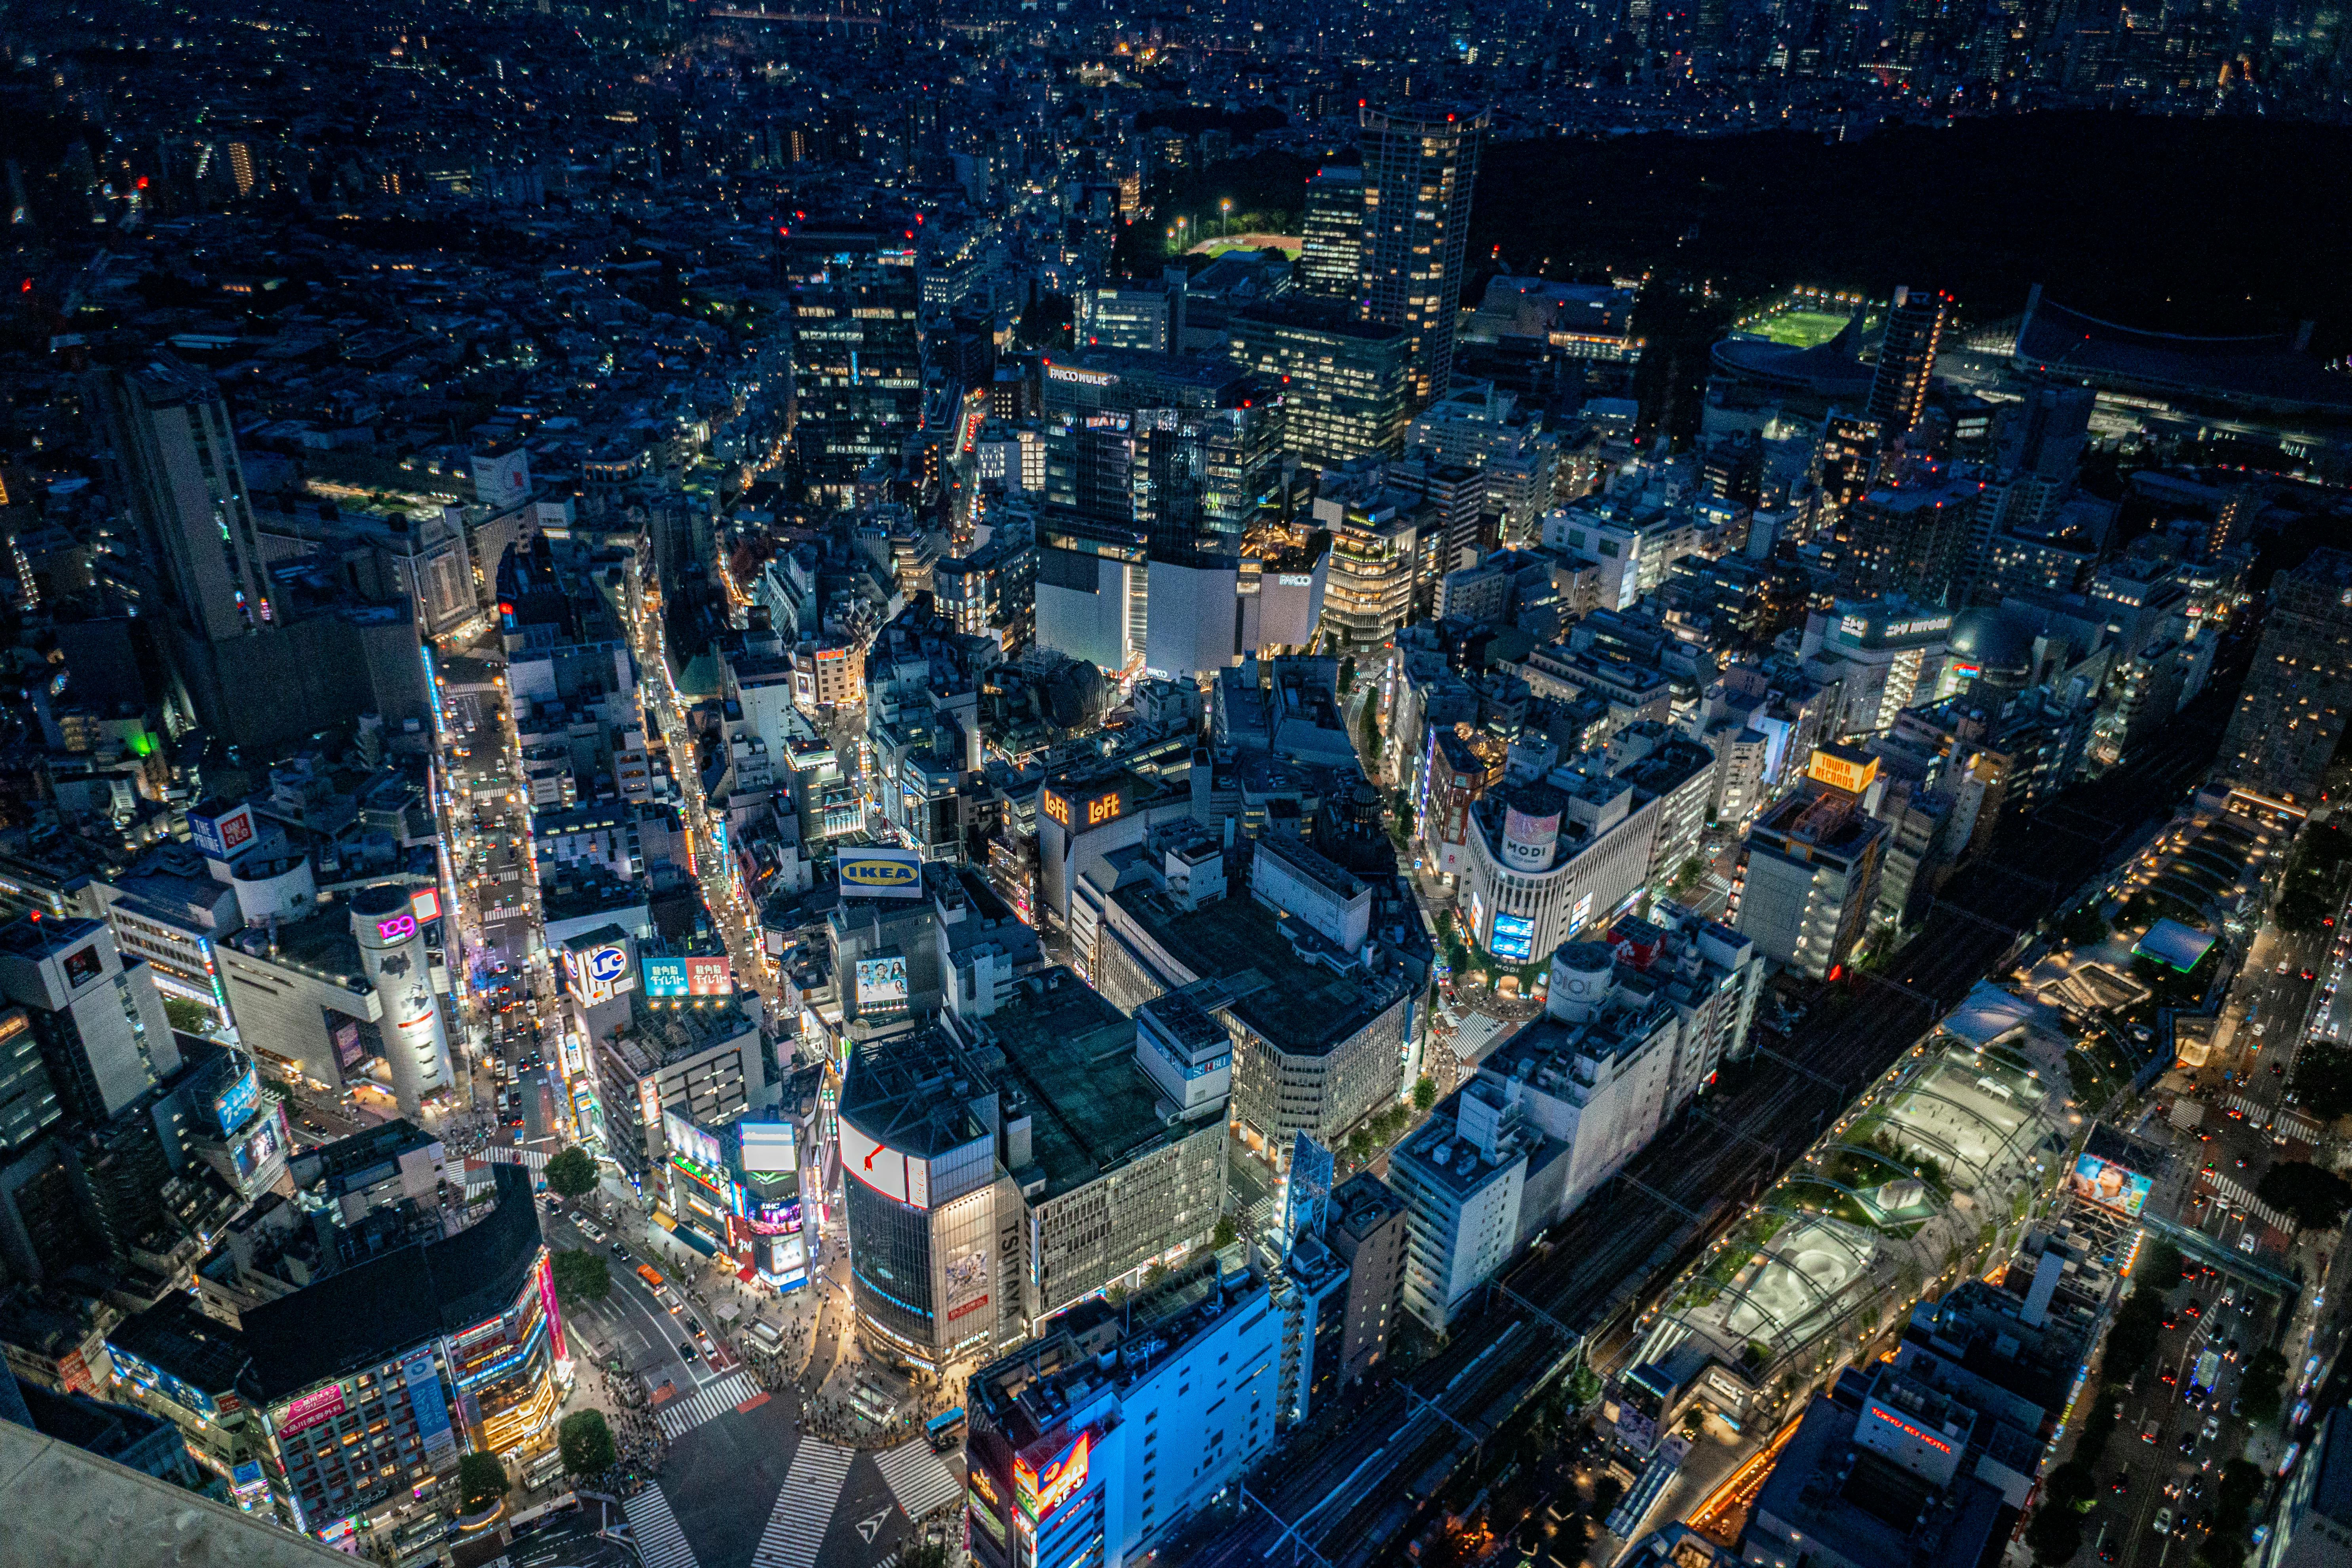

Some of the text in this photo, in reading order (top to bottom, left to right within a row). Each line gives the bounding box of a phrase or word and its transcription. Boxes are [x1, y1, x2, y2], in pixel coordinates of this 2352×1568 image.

[1051, 369, 1108, 386] PARCO HULIC
[1279, 575, 1311, 586] PARCO
[1886, 623, 1909, 636] ニトリ
[1146, 667, 1168, 678] PARCO
[1822, 756, 1850, 775] TOWER
[1816, 766, 1853, 789] RECORDS
[224, 818, 244, 834] UNI
[228, 828, 249, 844] QLO
[1507, 841, 1545, 857] MODI
[849, 867, 912, 878] IKEA
[377, 914, 416, 939] 109
[1495, 964, 1519, 973] MODI
[1001, 1220, 1020, 1319] TSUTAYA
[954, 1330, 990, 1350] TSUTAYA
[493, 1344, 513, 1357] ガスト
[905, 1355, 935, 1372] TSUTAYA
[303, 1388, 336, 1406] 品川スキン
[305, 1394, 334, 1411] クリニック
[289, 1404, 342, 1432] 品川美容外科
[1871, 1406, 1951, 1454] TOKYU REI HOTEL
[1043, 1464, 1085, 1507] アコム
